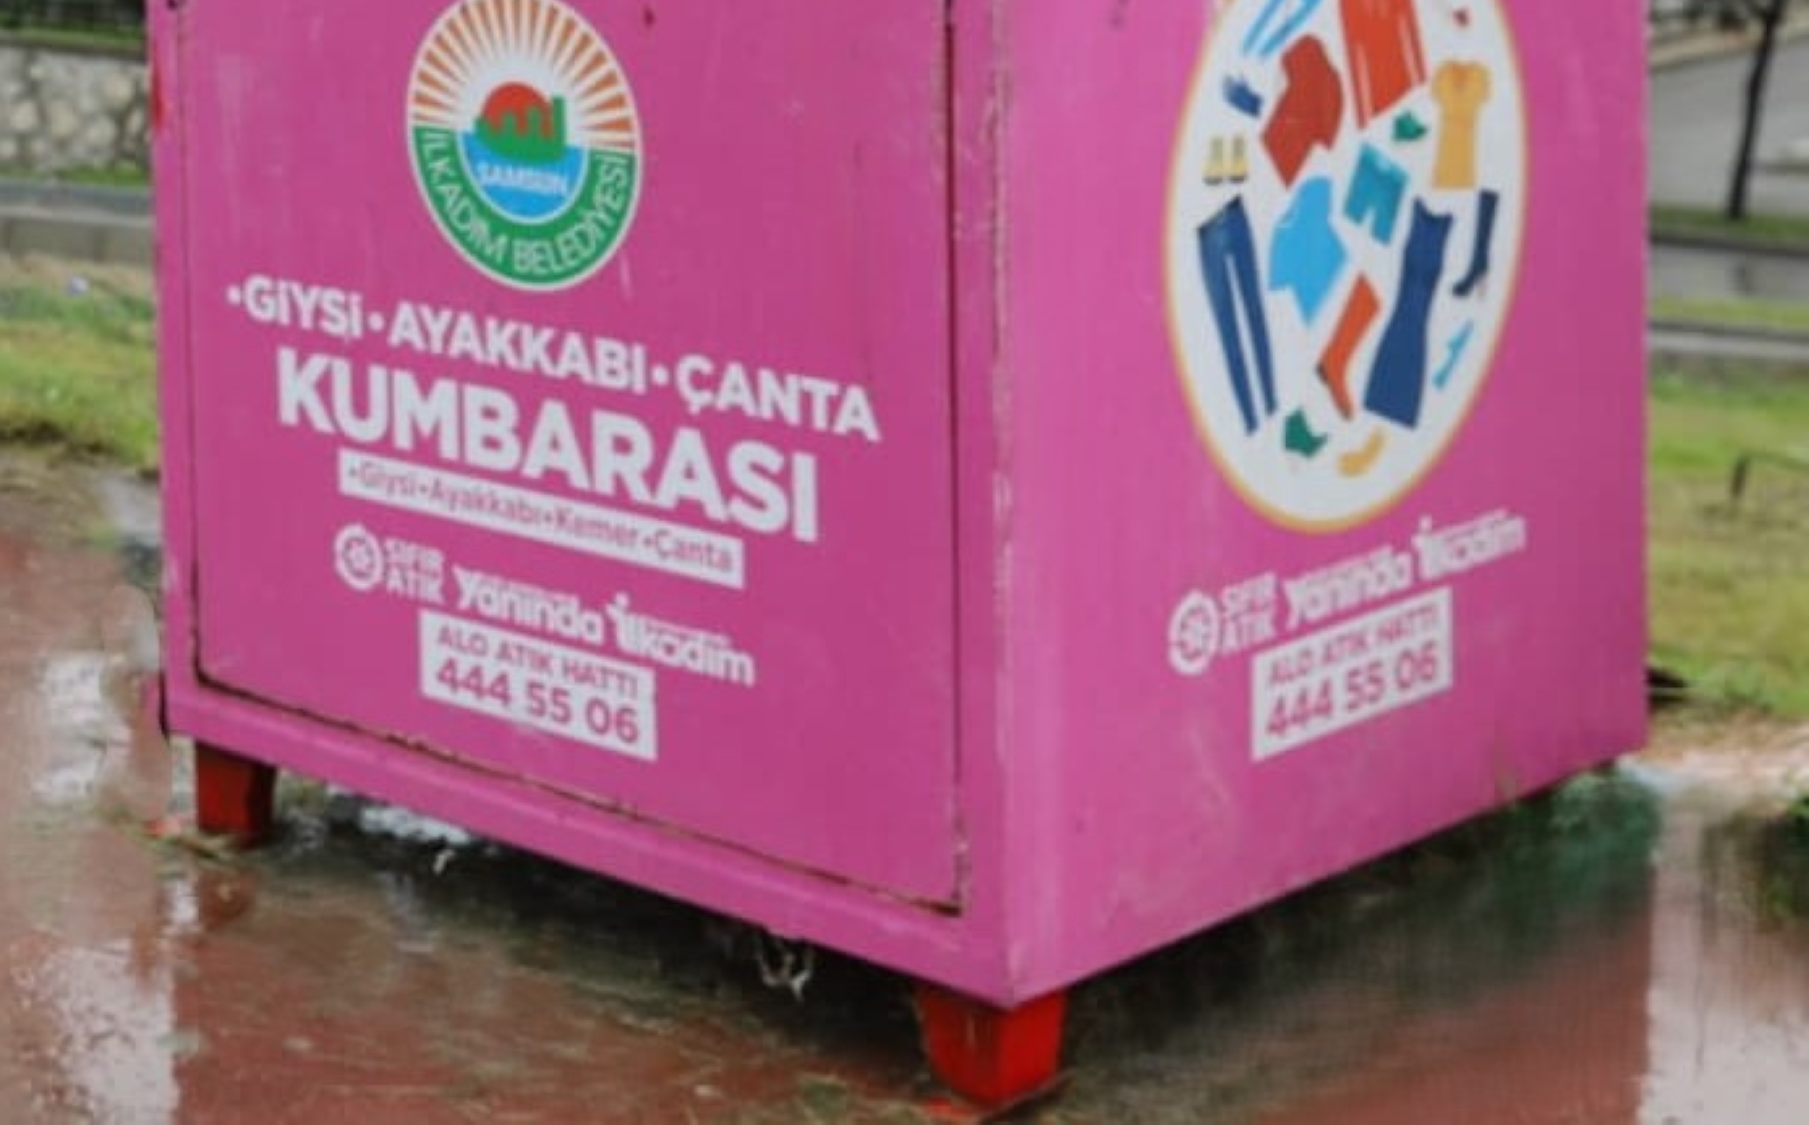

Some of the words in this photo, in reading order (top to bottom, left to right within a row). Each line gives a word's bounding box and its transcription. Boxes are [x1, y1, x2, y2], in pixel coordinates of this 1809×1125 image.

[388, 302, 646, 394] AYAKKABI
[676, 355, 881, 442] ÇANTA
[277, 346, 819, 543] KUMBARASI
[552, 502, 639, 547] Kemer
[654, 527, 734, 572] Çanta
[385, 566, 446, 605] ATIK
[435, 625, 487, 658] ALO
[494, 638, 553, 672] ATIK
[560, 653, 639, 699] HATTI
[1267, 647, 1314, 688] ALO
[1320, 628, 1369, 667] ATIK
[435, 657, 513, 706] 444
[525, 677, 573, 726] 55
[584, 697, 640, 744] 06
[1265, 678, 1334, 738] 444
[1344, 660, 1387, 713] 55
